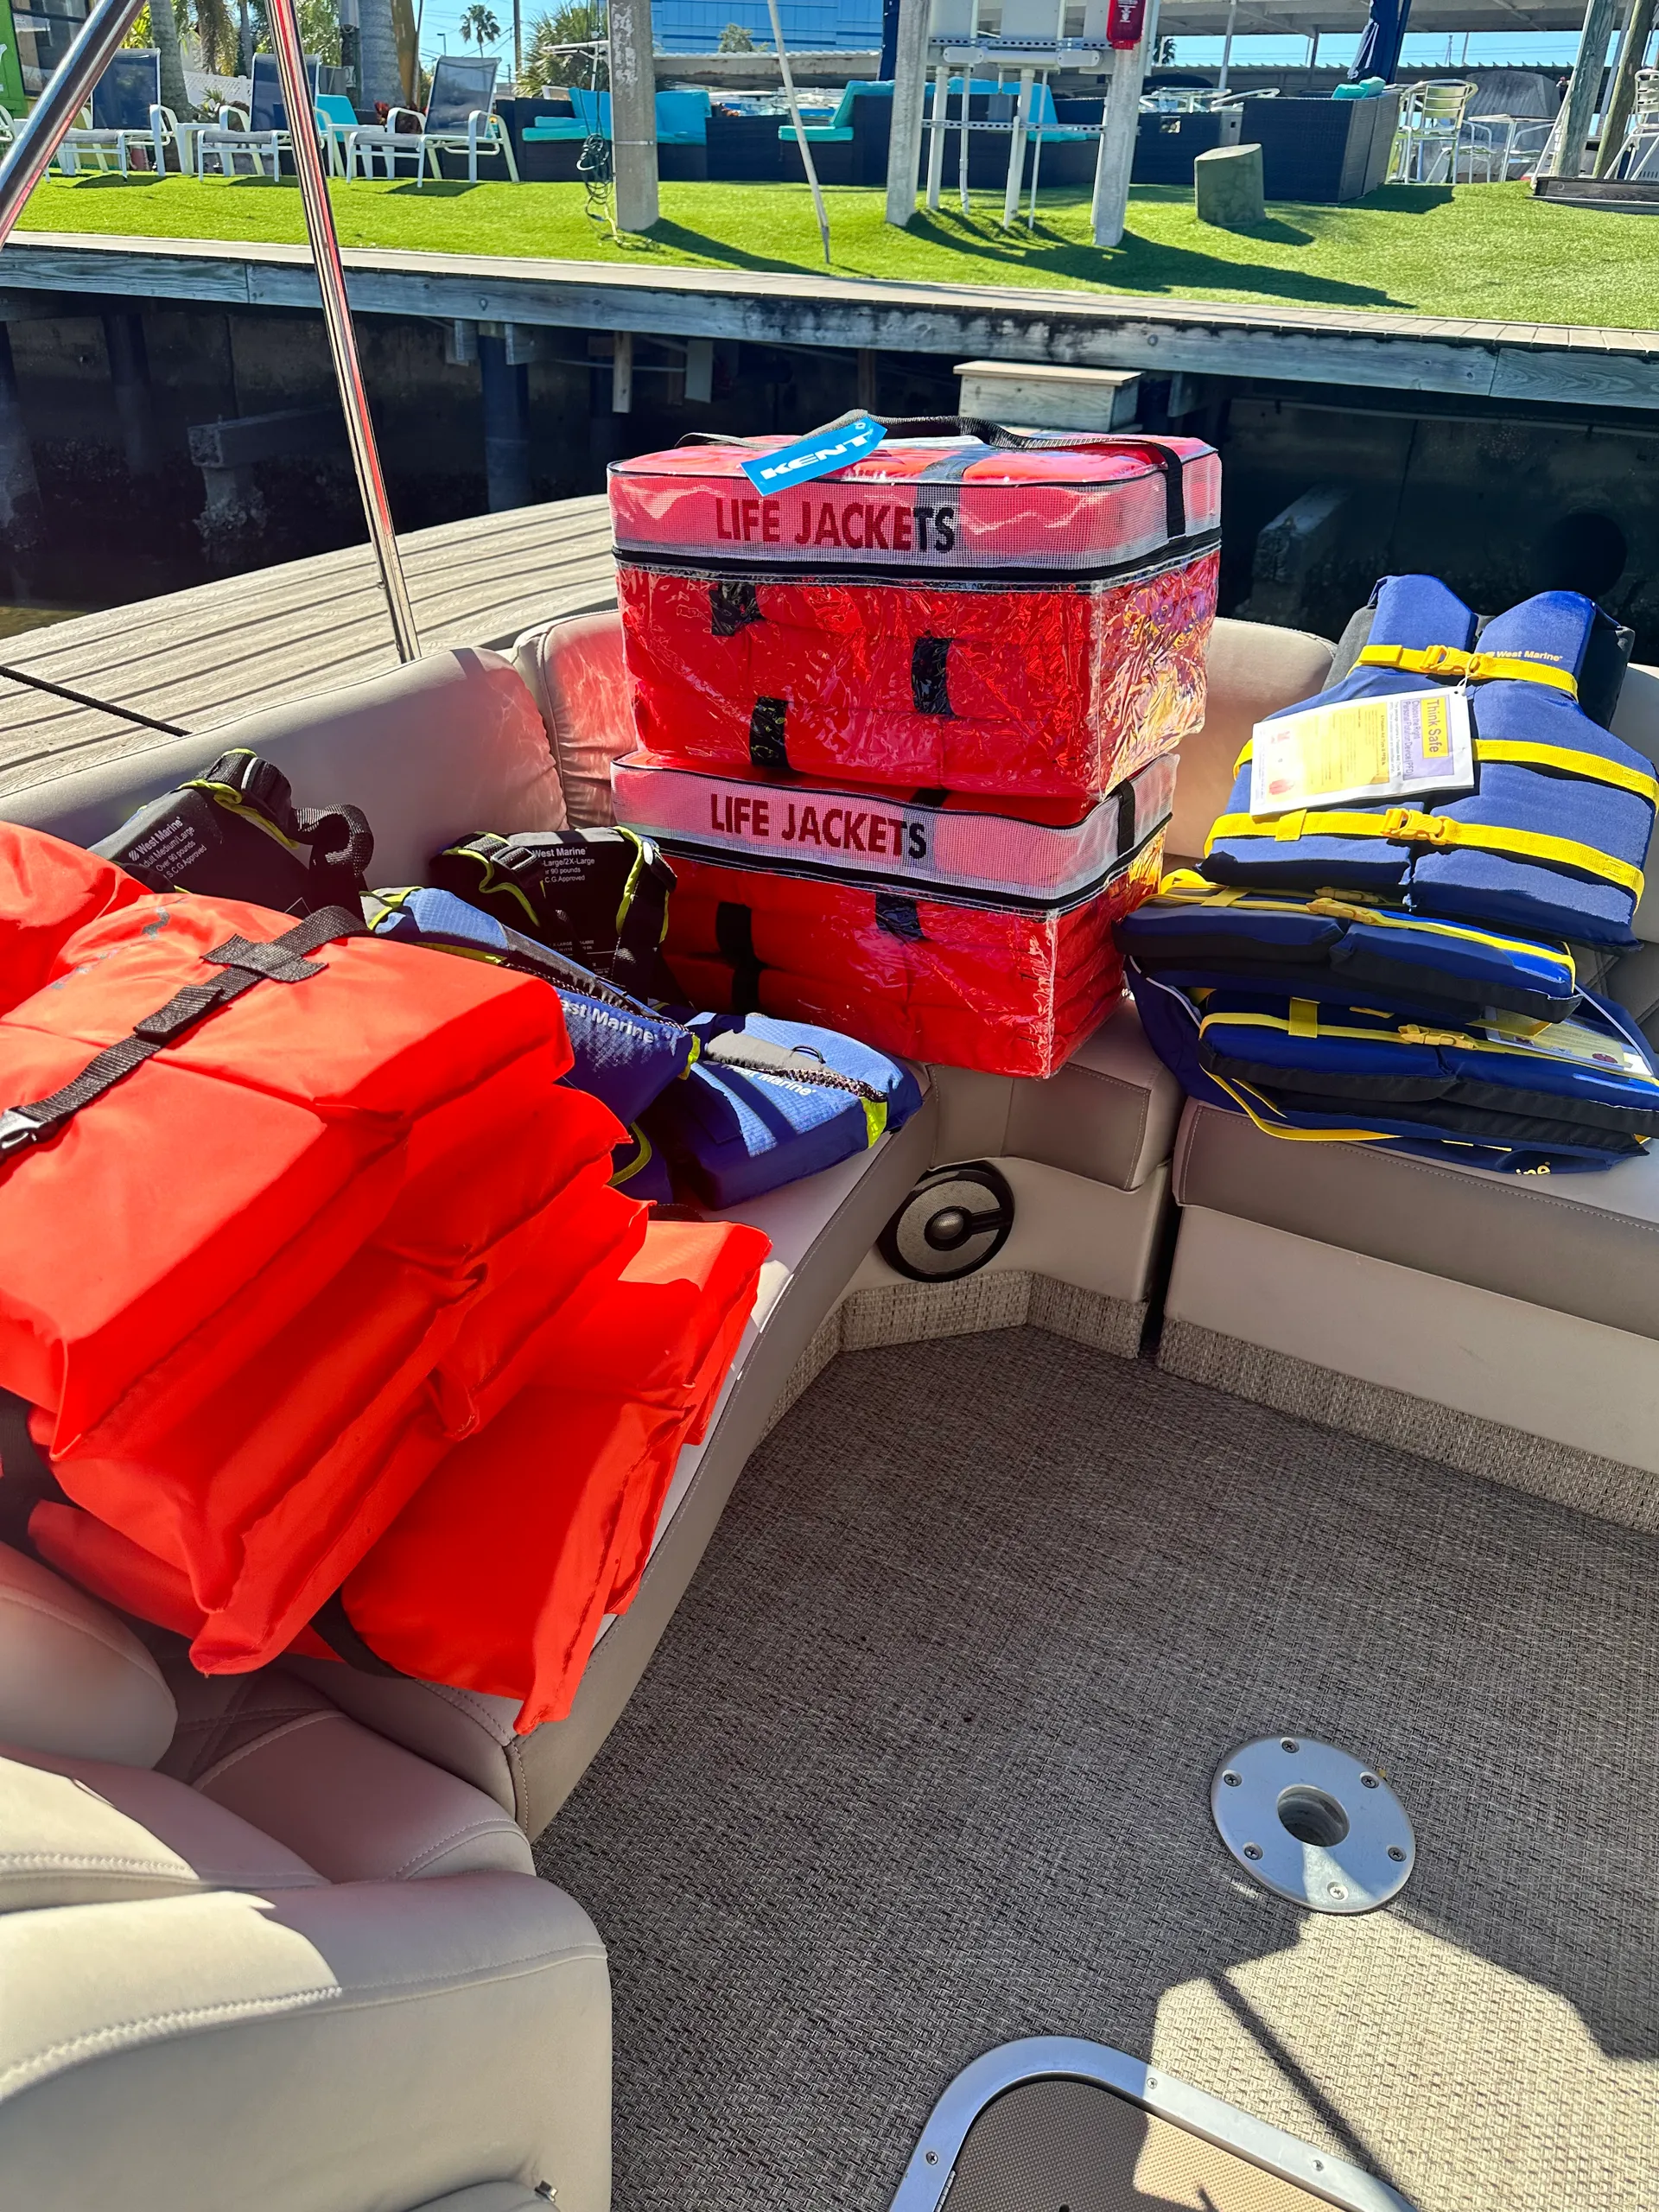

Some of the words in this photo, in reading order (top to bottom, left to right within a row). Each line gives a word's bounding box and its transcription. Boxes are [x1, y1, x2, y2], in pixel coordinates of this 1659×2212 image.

[760, 428, 874, 480] KENT
[715, 498, 780, 543] LIFE
[794, 501, 955, 553] JACKETS
[1523, 650, 1560, 662] Marine
[1427, 699, 1442, 727] Think
[1428, 728, 1442, 753] Safe
[135, 836, 160, 855] West
[154, 817, 184, 842] Marine
[155, 826, 195, 861] Medium/Large
[710, 793, 769, 837] LIFE
[781, 803, 927, 860] JACKETS
[156, 859, 171, 873] Over
[168, 853, 178, 863] 90
[176, 840, 196, 859] pounds
[556, 848, 586, 856] Marine
[559, 998, 588, 1018] est
[592, 1007, 654, 1044] Marine
[757, 1073, 812, 1096] Marine
